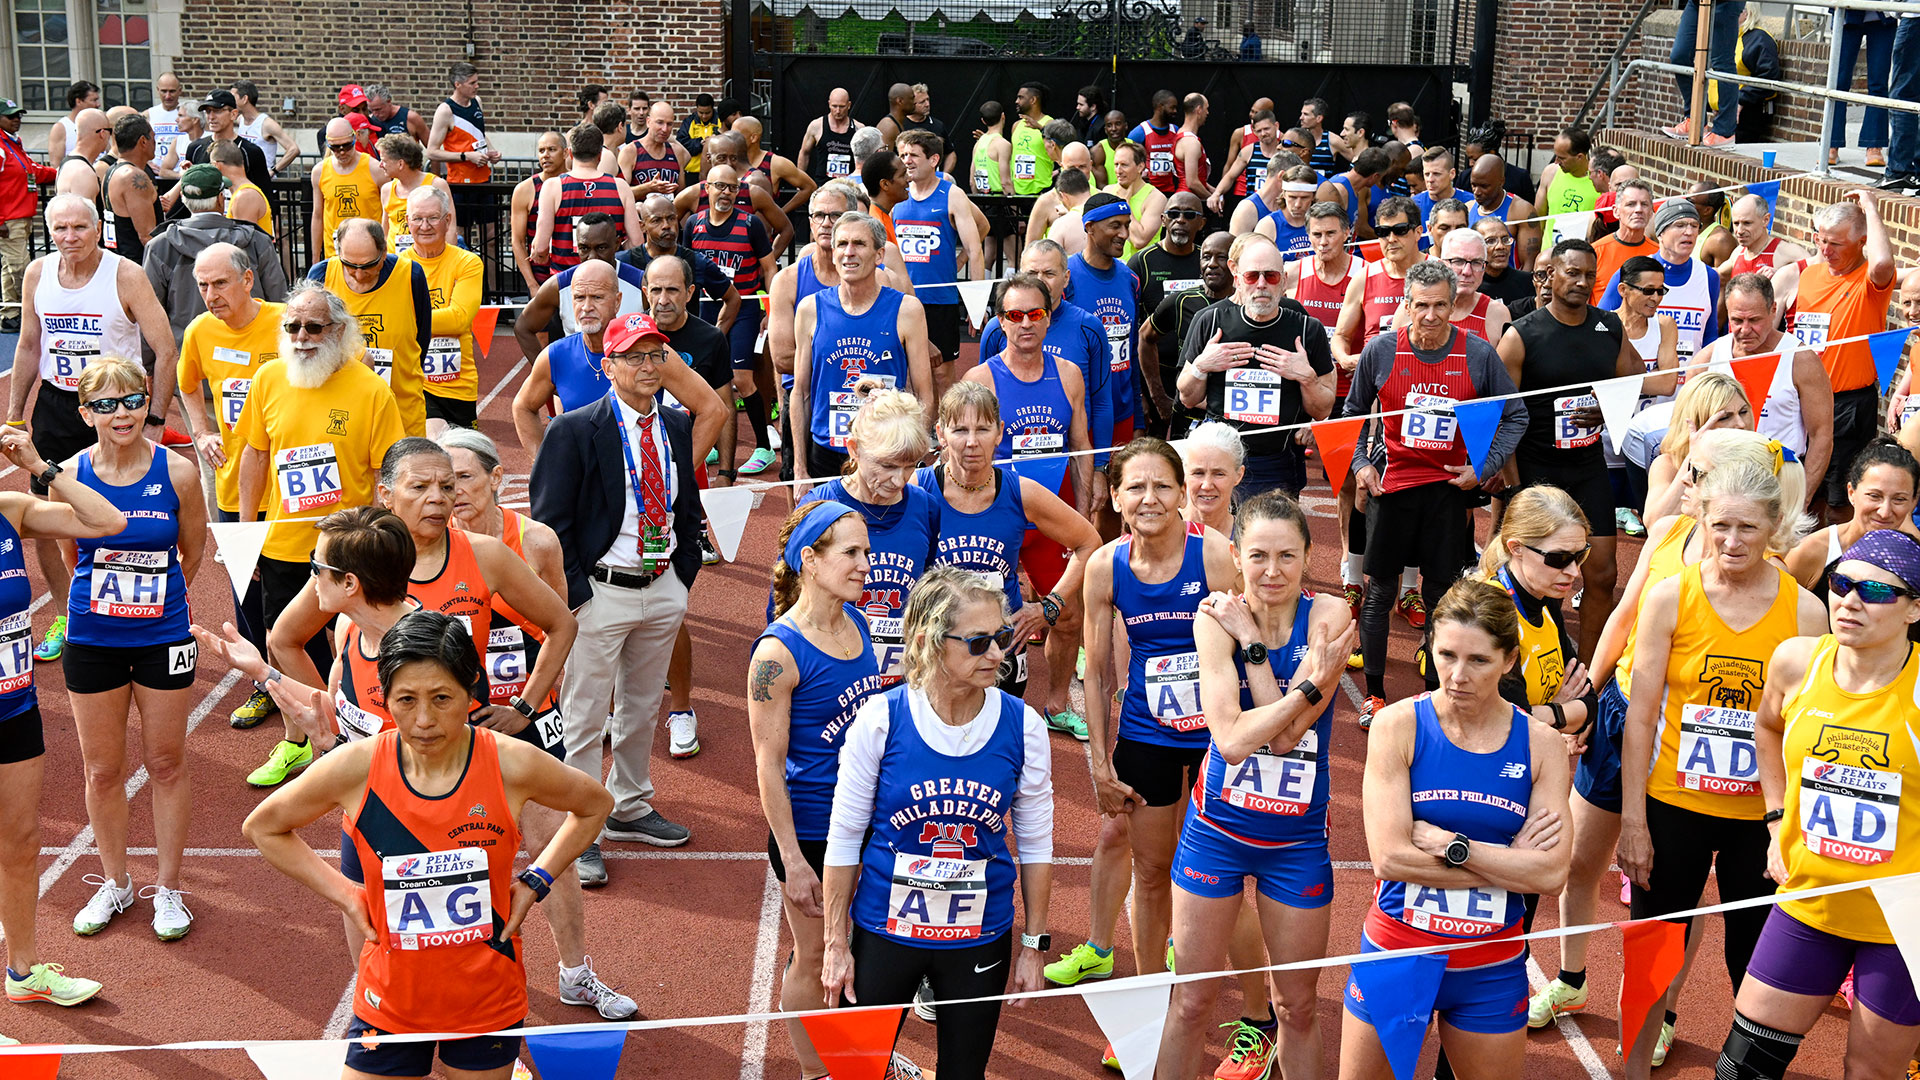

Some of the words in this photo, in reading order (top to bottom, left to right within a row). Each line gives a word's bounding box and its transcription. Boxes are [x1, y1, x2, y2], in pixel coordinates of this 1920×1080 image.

[1096, 297, 1122, 306] GREATER
[1304, 299, 1322, 308] MASS
[1324, 302, 1343, 310] VELOC
[1094, 306, 1131, 321] HILADELPHIA
[1683, 312, 1702, 326] A.C.
[45, 317, 79, 331] SHORE
[82, 319, 102, 331] A.C.
[836, 337, 872, 348] GREATER
[826, 347, 881, 365] PHILADELPHIA
[1043, 345, 1062, 355] ATER
[1112, 363, 1128, 371] OYOTA
[430, 374, 457, 382] TOYOTA
[1411, 383, 1449, 395] MVTC
[1016, 405, 1052, 417] GREATER
[1240, 414, 1274, 423] TOYOTA
[1006, 415, 1063, 436] PHILADELPHIA
[1416, 439, 1448, 449] TOYOTA
[1572, 435, 1597, 446] TOYOTA
[299, 446, 319, 455] PENN
[299, 450, 327, 460] RELAYS
[300, 492, 336, 506] TOYOTA
[937, 535, 1005, 555] GREATER
[125, 557, 159, 566] RELAYS
[127, 552, 153, 560] PENN
[868, 552, 914, 572] EATER
[865, 568, 915, 591] ADELPH
[112, 604, 157, 616] TOYOTA
[439, 597, 469, 612] CENTRAL
[469, 597, 485, 607] PARK
[1125, 614, 1153, 625] GREATER
[174, 647, 195, 670] AH
[1176, 662, 1200, 671] RELA
[1710, 661, 1758, 677] philadelphia
[1157, 675, 1178, 683] Dream
[1718, 668, 1749, 679] masters
[489, 685, 519, 695] YOTA
[1720, 709, 1750, 720] PENN
[544, 715, 564, 743] AG
[1174, 716, 1206, 730] TOYO
[1694, 726, 1718, 735] Dream
[1718, 728, 1731, 737] On.
[1827, 732, 1880, 752] philadelphia
[1833, 741, 1870, 753] masters
[1841, 767, 1877, 780] PENN
[1703, 777, 1754, 793] TOYOTA
[1839, 776, 1887, 791] RELAYS
[910, 778, 1002, 808] GREATER
[1814, 783, 1840, 794] Dream
[1840, 787, 1855, 798] On.
[1248, 796, 1300, 814] TOYOTA
[1412, 789, 1459, 802] GREATER
[1461, 790, 1527, 817] PHILADELPHIA
[448, 822, 486, 839] CENTRAL
[486, 823, 505, 836] PARK
[1823, 840, 1882, 863] TOYOTA
[426, 853, 462, 866] PENN
[936, 861, 969, 870] PENN
[425, 860, 475, 875] RELAYS
[934, 868, 975, 879] RELAYS
[1184, 867, 1219, 885] GPTC
[400, 880, 427, 889] Dream
[427, 878, 443, 886] On.
[908, 879, 933, 889] Dream
[933, 882, 947, 890] On.
[916, 926, 971, 937] TOYOTA
[1433, 917, 1493, 934] TOYOTA
[421, 929, 485, 947] TOYOTA
